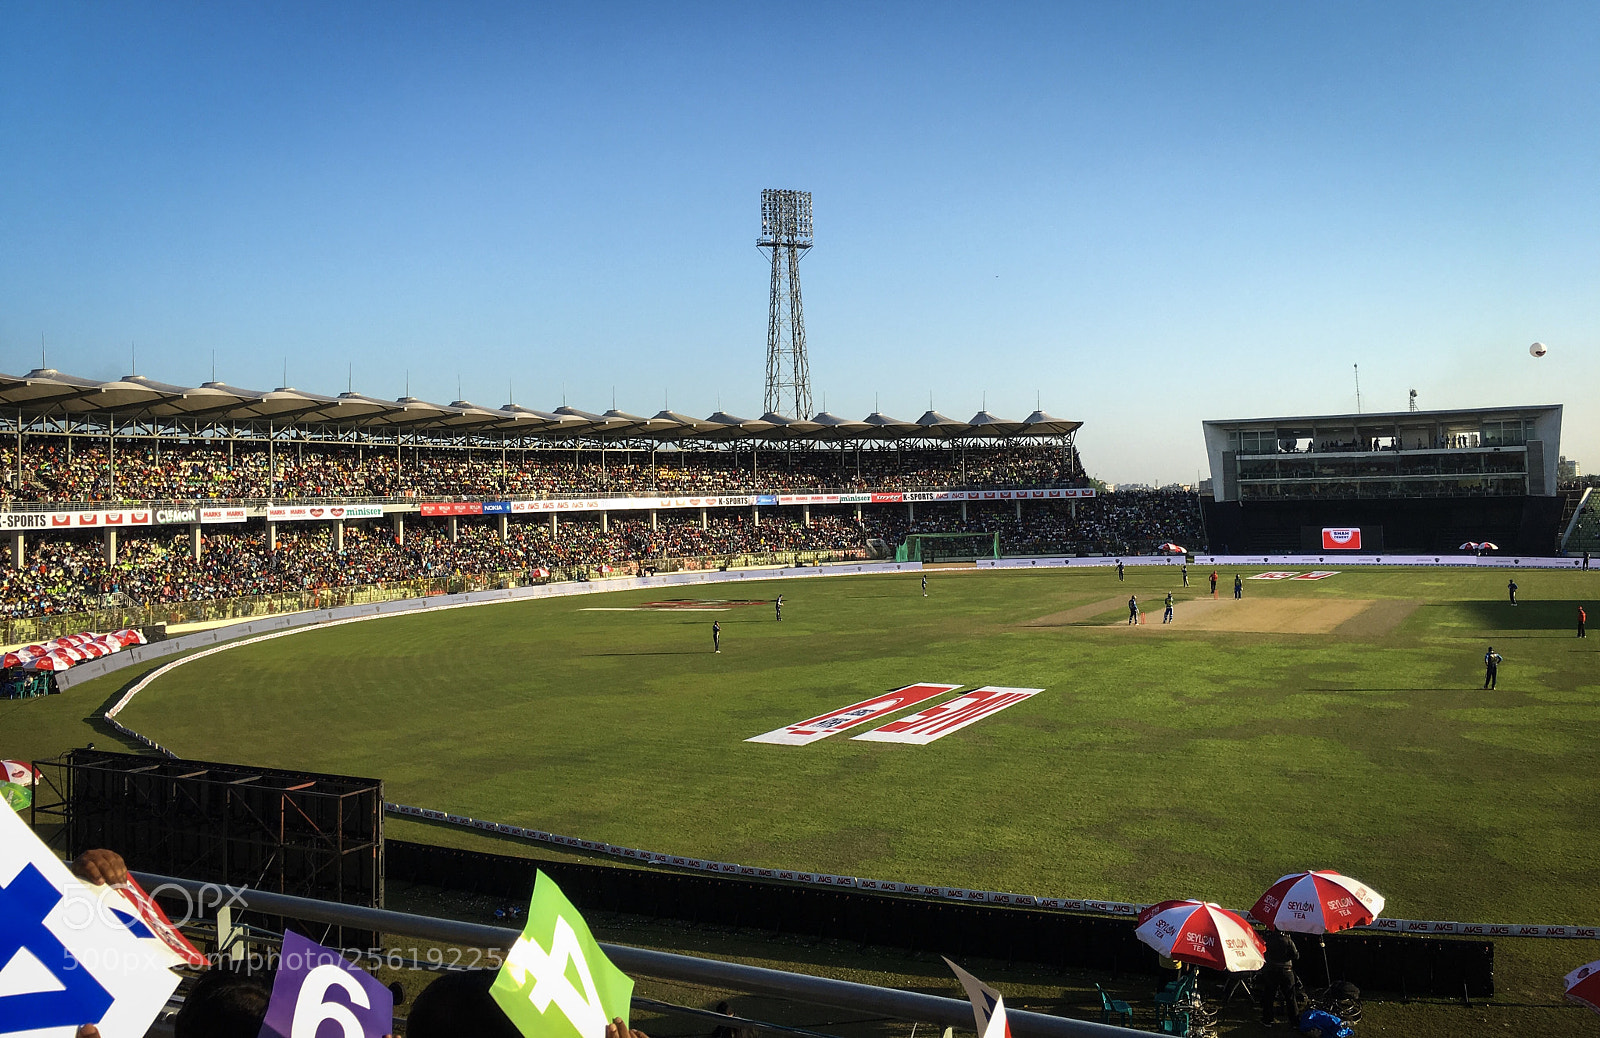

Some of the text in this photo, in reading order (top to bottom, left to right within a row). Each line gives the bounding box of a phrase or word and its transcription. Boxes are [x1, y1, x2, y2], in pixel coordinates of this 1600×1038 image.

[719, 497, 748, 505] K-SPORTS
[903, 493, 934, 501] K-SPORTS
[346, 507, 382, 516] minister
[0, 514, 46, 528] -SPORTS
[156, 510, 196, 524] CLEMON
[1288, 900, 1314, 912] SEYLON
[1328, 897, 1354, 910] SEYLON
[1408, 922, 1428, 930] AKS
[1434, 923, 1453, 931] AKS
[1155, 930, 1164, 938] TEA
[1187, 932, 1214, 946] SEYLON
[1193, 944, 1206, 953] TEA
[290, 964, 371, 1038] 6
